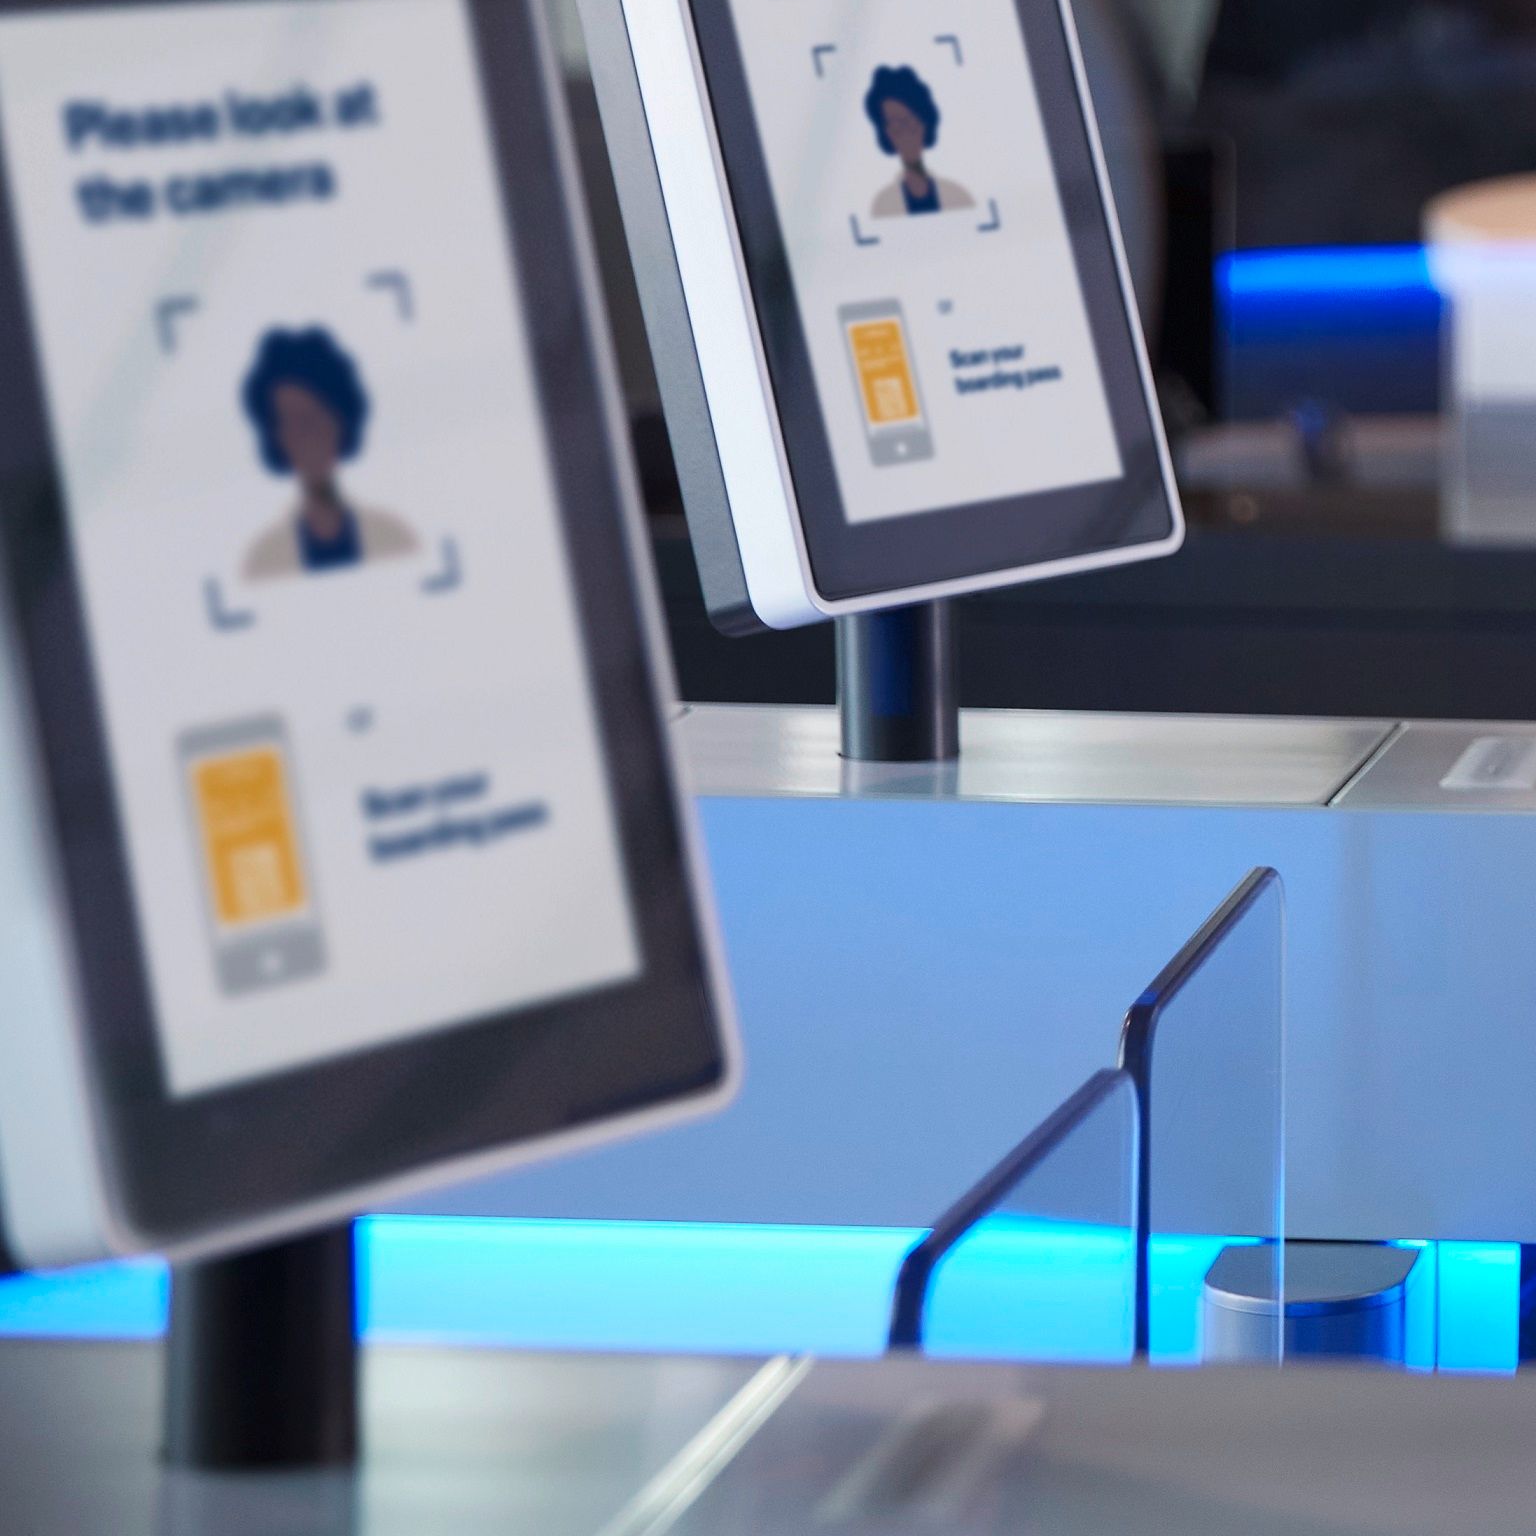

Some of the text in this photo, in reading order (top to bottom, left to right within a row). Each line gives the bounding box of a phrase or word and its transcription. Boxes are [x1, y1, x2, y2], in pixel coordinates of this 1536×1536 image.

[61, 76, 380, 153] Please look at
[75, 161, 335, 227] the camera
